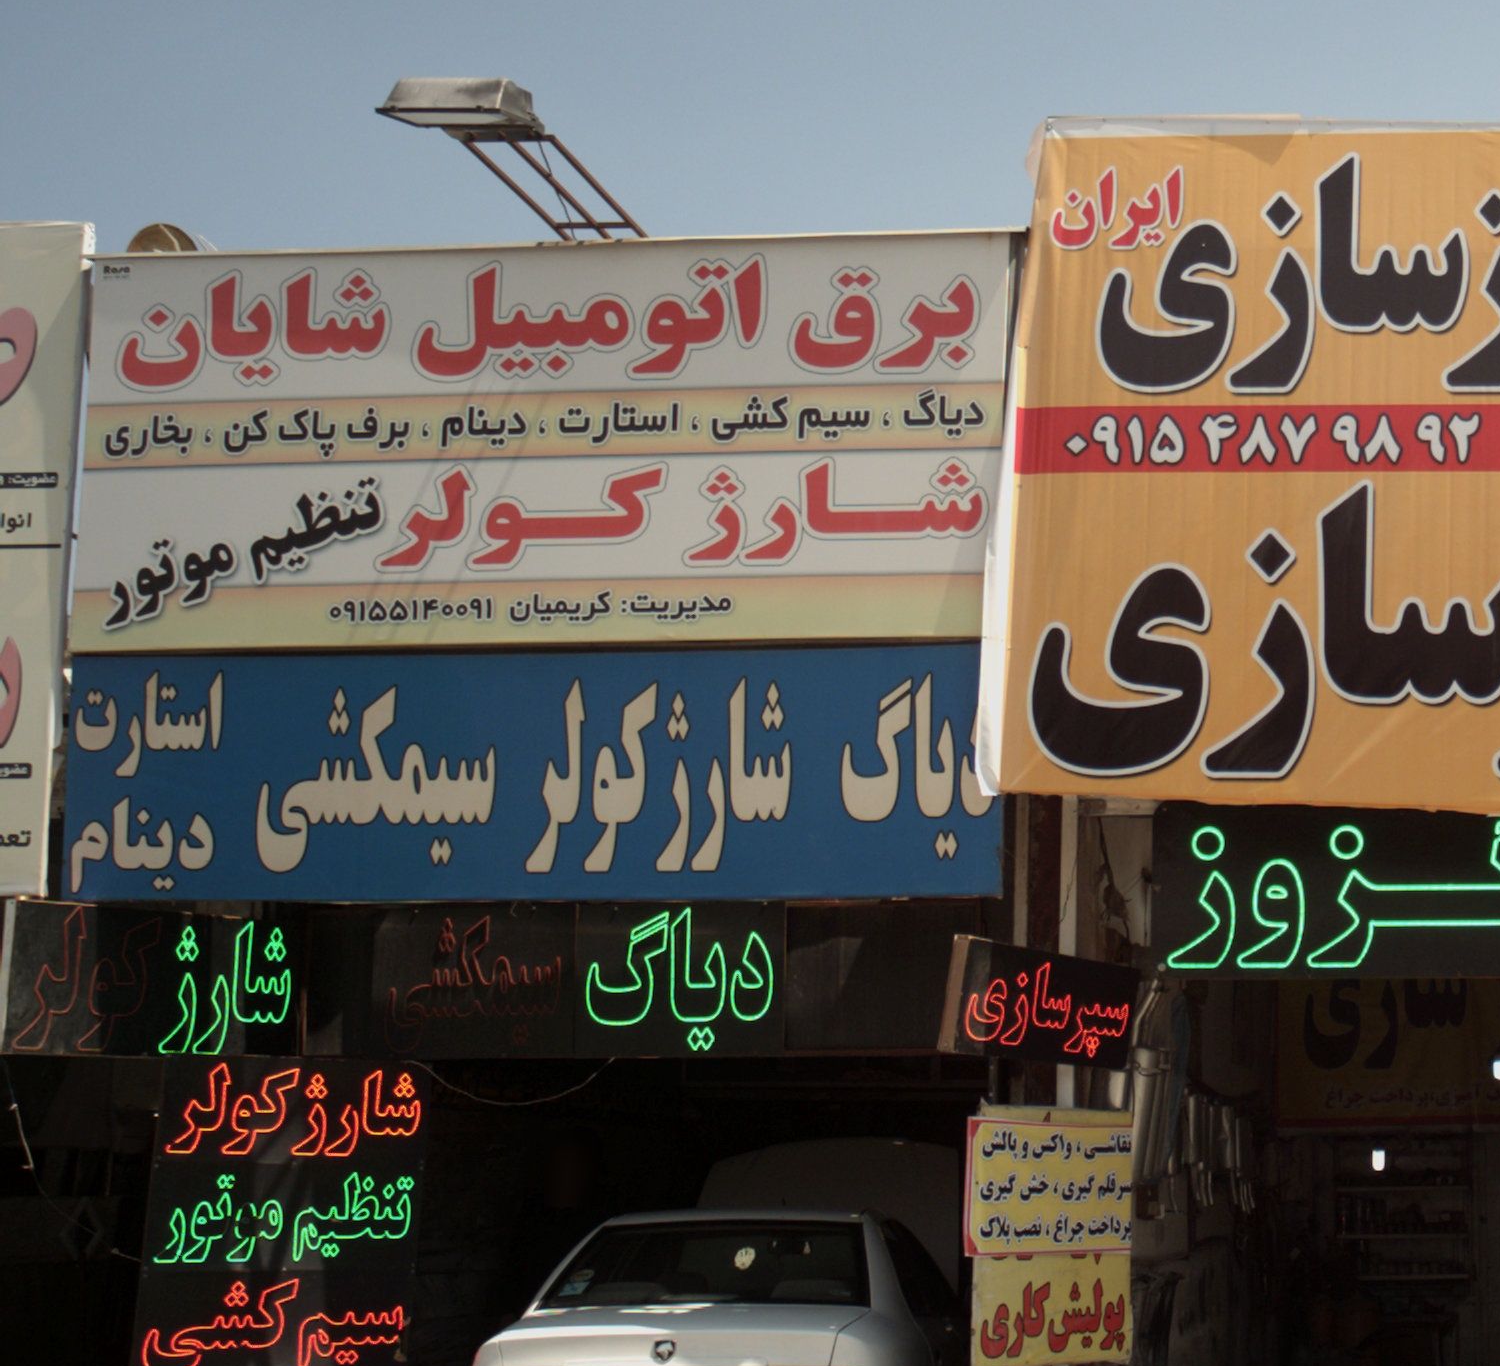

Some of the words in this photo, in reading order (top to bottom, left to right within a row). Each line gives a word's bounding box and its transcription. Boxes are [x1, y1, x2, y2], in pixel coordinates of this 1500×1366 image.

[1049, 166, 1183, 251] ایران
[120, 272, 386, 387] شایان
[417, 257, 763, 377] اتومبیل
[795, 269, 975, 369] برق
[105, 414, 193, 458] بخاری
[223, 411, 269, 455] کن
[279, 411, 337, 457] پاک
[346, 407, 410, 450] برف
[441, 406, 527, 448] دینام
[558, 403, 680, 446] استارت
[711, 396, 789, 442] کشی
[798, 404, 870, 439] سیم
[902, 390, 986, 439] دیاگ
[251, 476, 382, 580] تنظیم
[379, 466, 664, 568] کولر
[690, 460, 983, 564] شارژ
[105, 538, 235, 628] موتور
[510, 591, 612, 622] کریمیان
[74, 669, 225, 778] استارت
[841, 672, 996, 859] دیاگ
[525, 677, 659, 872] کولر
[656, 677, 792, 872] شارژ
[70, 795, 214, 895] دینام
[158, 920, 292, 1056] شارژ
[586, 907, 774, 1051] دیاگ
[165, 1062, 302, 1156] کولر
[291, 1069, 422, 1157] شارژ
[153, 1173, 284, 1264] موتور
[292, 1172, 415, 1263] تنظیم
